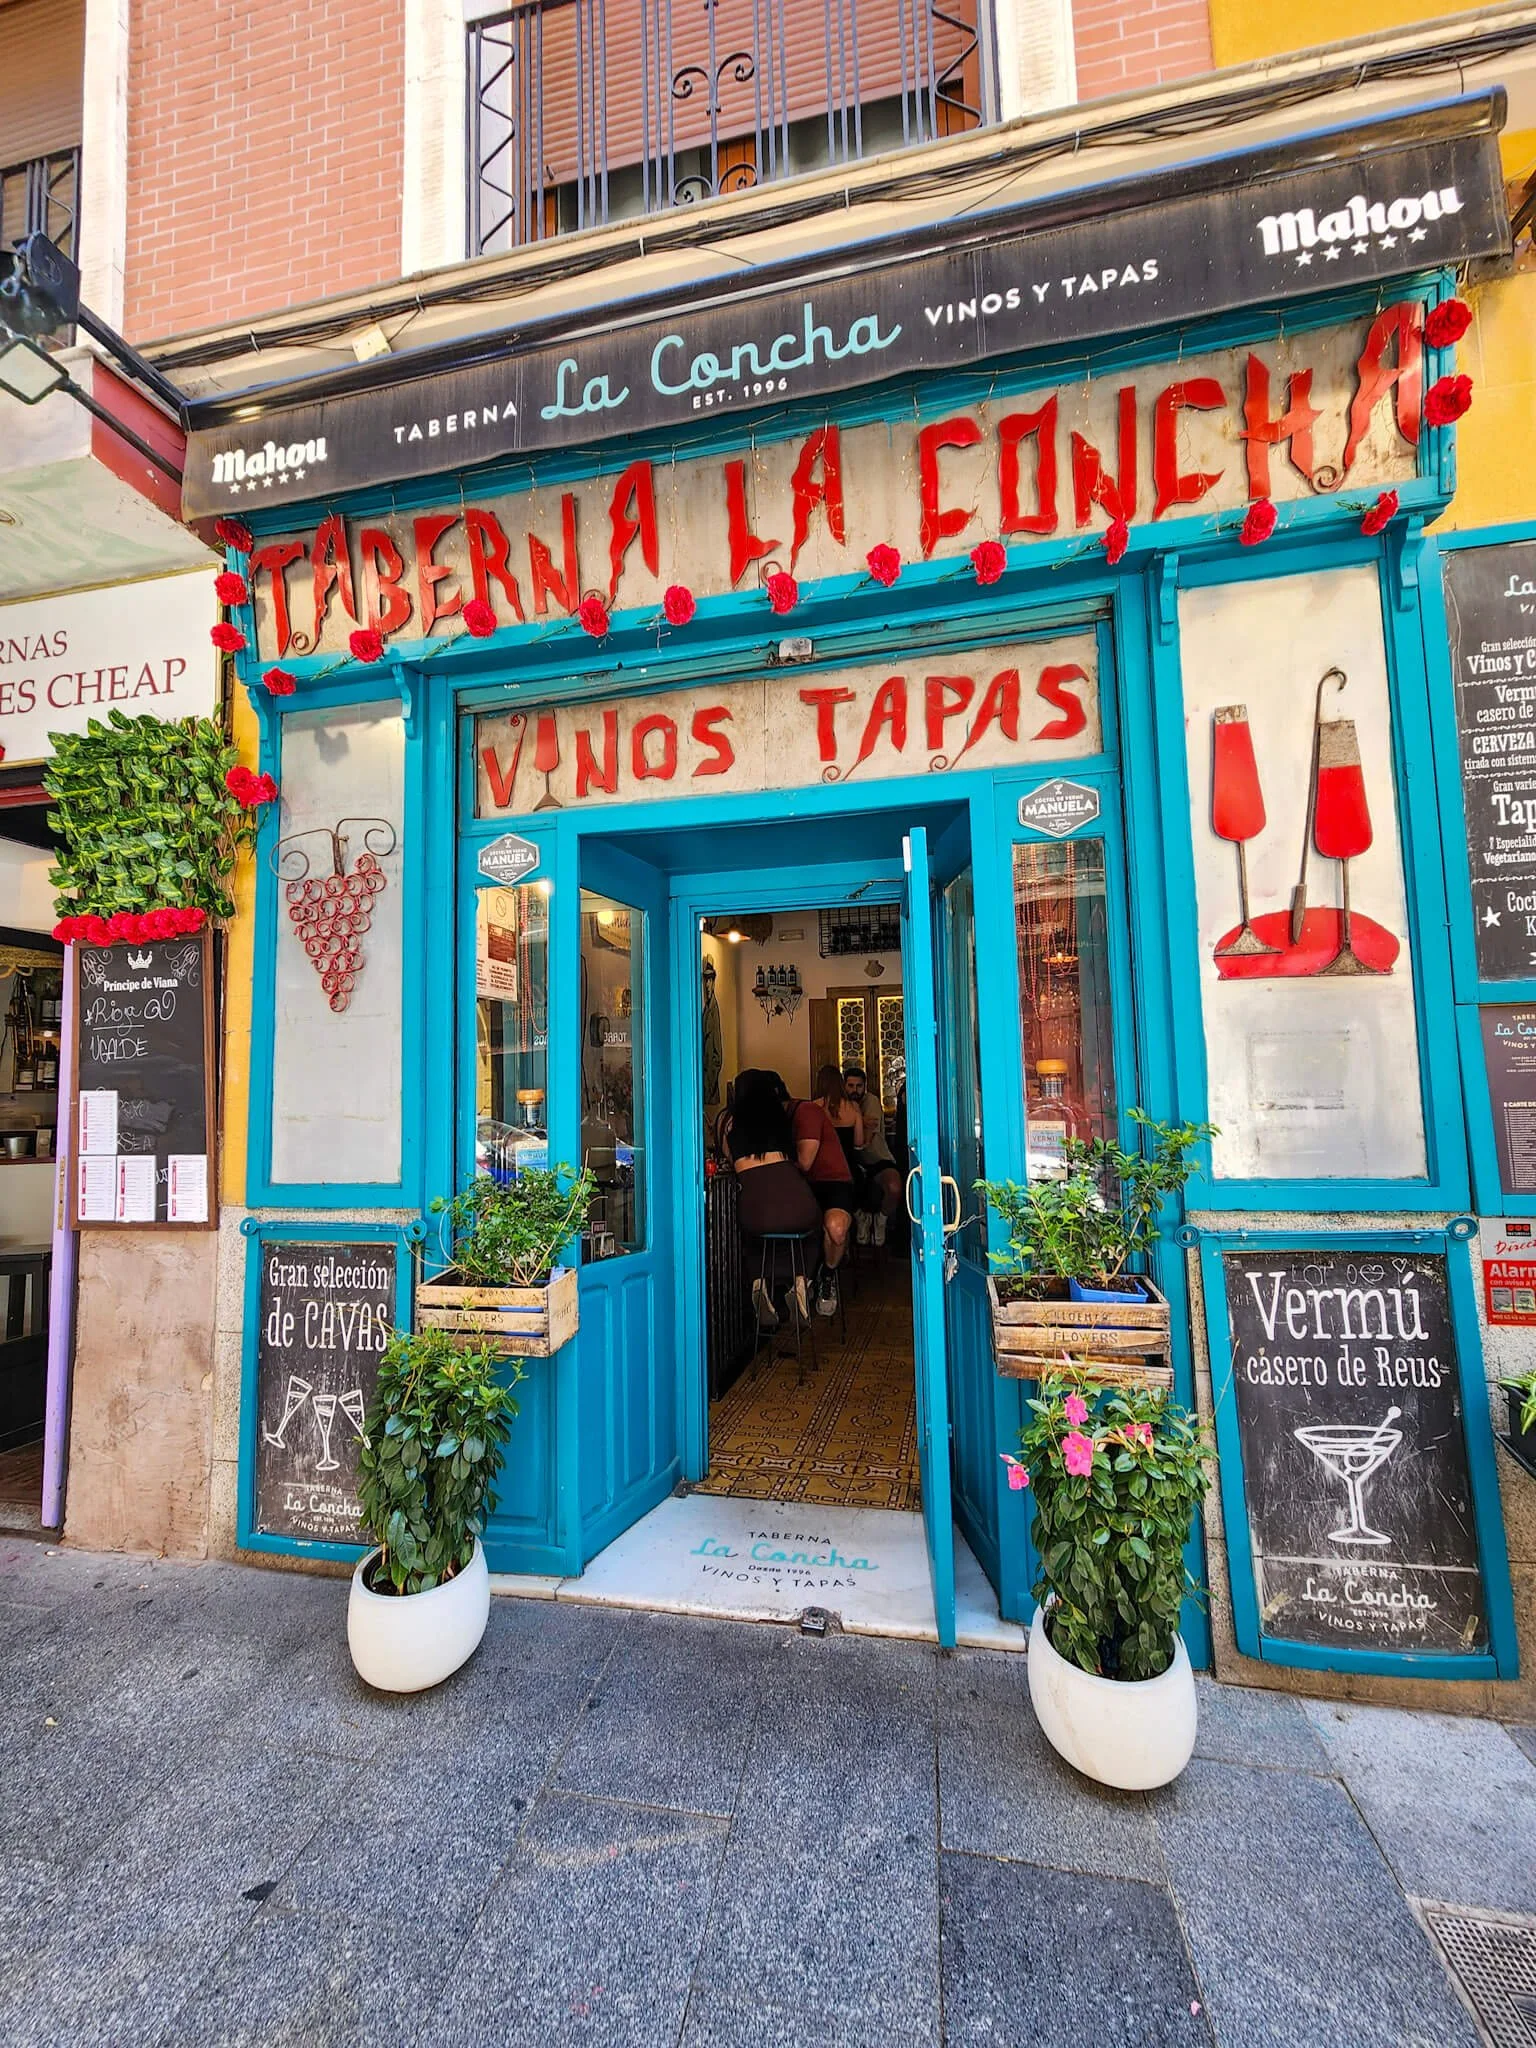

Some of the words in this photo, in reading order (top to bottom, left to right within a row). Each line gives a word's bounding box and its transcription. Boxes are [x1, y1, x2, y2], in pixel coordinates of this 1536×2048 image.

[1257, 186, 1465, 257] Mahou
[924, 287, 1021, 327] VINOS
[1032, 282, 1051, 304] Y
[1062, 258, 1160, 297] TAPAS
[540, 357, 630, 420] La
[650, 302, 902, 395] Concha
[692, 389, 733, 409] EST.
[744, 378, 789, 398] 1996
[393, 400, 519, 444] TABERNA
[211, 436, 328, 483] Mahou
[249, 459, 660, 658] TABERNA
[725, 424, 847, 592] LA
[919, 301, 1425, 560] CONCHA
[1503, 574, 1536, 597] La
[1481, 641, 1501, 653] Gran
[1466, 654, 1512, 674] Vinos
[1513, 654, 1524, 675] y
[47, 658, 187, 709] CHEAP
[800, 664, 1091, 783] TAPAS
[1476, 704, 1516, 723] casero
[1519, 701, 1533, 719] de
[1473, 731, 1536, 754] CERVEZA
[1464, 756, 1490, 770] tirada
[1491, 757, 1506, 768] con
[1493, 780, 1514, 792] Gran
[1025, 799, 1094, 816] MANUELA
[1491, 793, 1536, 833] Tap
[482, 852, 535, 867] MANUELA
[1507, 890, 1536, 912] Coci
[141, 977, 152, 989] de
[153, 976, 178, 988] Viana
[1495, 1022, 1514, 1036] La
[90, 1035, 149, 1064] UGALDE
[1503, 1040, 1528, 1049] VINOS
[269, 1256, 309, 1288] Gran
[313, 1256, 389, 1290] selección
[1245, 1271, 1429, 1341] Vermú
[267, 1297, 295, 1348] de
[304, 1301, 388, 1352] CAVAS
[1053, 1331, 1118, 1344] FLOWERS
[1246, 1354, 1328, 1387] casero
[1337, 1344, 1367, 1387] de
[1374, 1346, 1442, 1388] Reus
[284, 1493, 305, 1511] La
[310, 1494, 365, 1517] Concha
[291, 1516, 319, 1532] VINOS
[321, 1525, 328, 1533] Y
[329, 1523, 355, 1533] TAPAS
[749, 1531, 831, 1545] TABERNA
[690, 1537, 739, 1558] La
[751, 1542, 880, 1570] Concha
[702, 1564, 761, 1584] VINOS
[772, 1577, 782, 1586] Y
[792, 1577, 857, 1587] TAPAS
[748, 1564, 782, 1574] Desde
[786, 1568, 811, 1576] 1996
[1336, 1567, 1398, 1580] TABERNA
[1301, 1577, 1338, 1602] La
[1344, 1579, 1438, 1609] Concha
[1319, 1610, 1363, 1631] VINOS
[1369, 1622, 1377, 1632] Y
[1382, 1618, 1425, 1633] TAPAS
